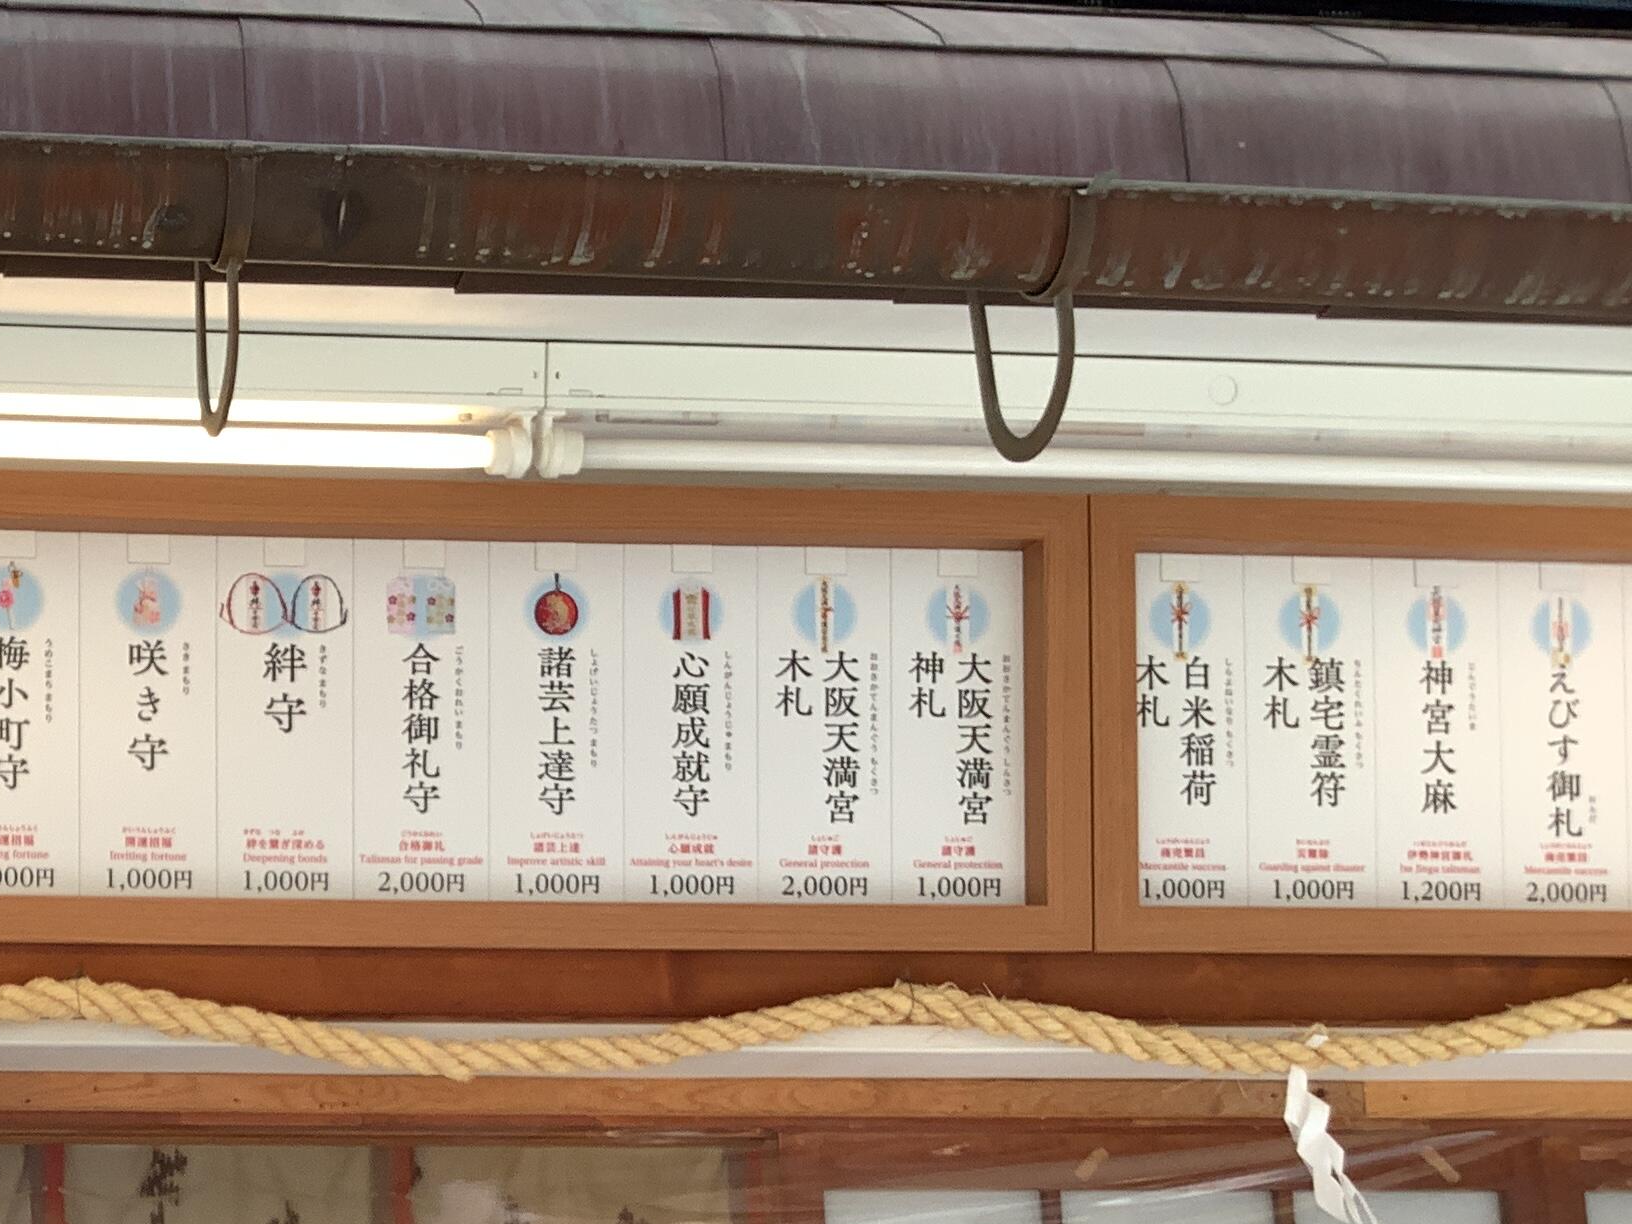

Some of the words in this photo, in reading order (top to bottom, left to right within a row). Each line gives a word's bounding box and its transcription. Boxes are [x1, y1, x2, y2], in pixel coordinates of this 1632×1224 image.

[263, 643, 307, 733] 絆守
[776, 649, 812, 716] 木札
[909, 651, 946, 718] 神札
[1135, 653, 1169, 730] 木札
[1264, 657, 1299, 729] 木札
[128, 640, 168, 771] 咲き守
[402, 643, 440, 813] 合格御礼守
[538, 646, 576, 815] 諸芸上達守
[672, 652, 710, 816] 心願成就守
[821, 649, 860, 823] 大阪天満宮
[957, 653, 993, 824] 大阪天満宮
[1177, 654, 1216, 806] 白米稲荷
[1306, 657, 1345, 807] 鎮宅霊符
[1420, 660, 1457, 814] 神宮大麻
[1548, 661, 1582, 837] えびす御札
[125, 837, 172, 848] 開運招福
[400, 840, 444, 851] 合格御礼
[534, 842, 579, 853] 諸芸上達
[670, 844, 714, 854] 心願成就
[12, 849, 49, 859] fortune
[109, 851, 147, 862] Inviting
[151, 852, 187, 861] fortune
[242, 853, 294, 865] Deepening
[298, 854, 327, 863] bonds
[404, 855, 416, 864] for
[419, 856, 453, 866] passing
[455, 856, 484, 866] grade
[507, 856, 544, 868] Improve
[547, 857, 582, 866] artistic
[586, 857, 606, 866] skill
[630, 858, 669, 869] Attaining
[671, 860, 691, 868] your
[727, 858, 753, 867] desire
[779, 859, 817, 868] General
[820, 859, 870, 870] protection
[912, 860, 951, 869] General
[954, 861, 1004, 870] protection
[107, 868, 192, 891] 1,000円
[245, 871, 328, 893] 1,000円
[378, 872, 464, 895] 2,000円
[516, 874, 599, 896] 1,000円
[650, 875, 734, 897] 1,000円
[782, 876, 867, 898] 2,000円
[919, 877, 1001, 900] 1,000円
[1141, 879, 1224, 902] 1,000円
[1275, 880, 1354, 902] 1,000円
[1403, 881, 1481, 903] 1,200円
[1526, 882, 1607, 904] 2,000円
